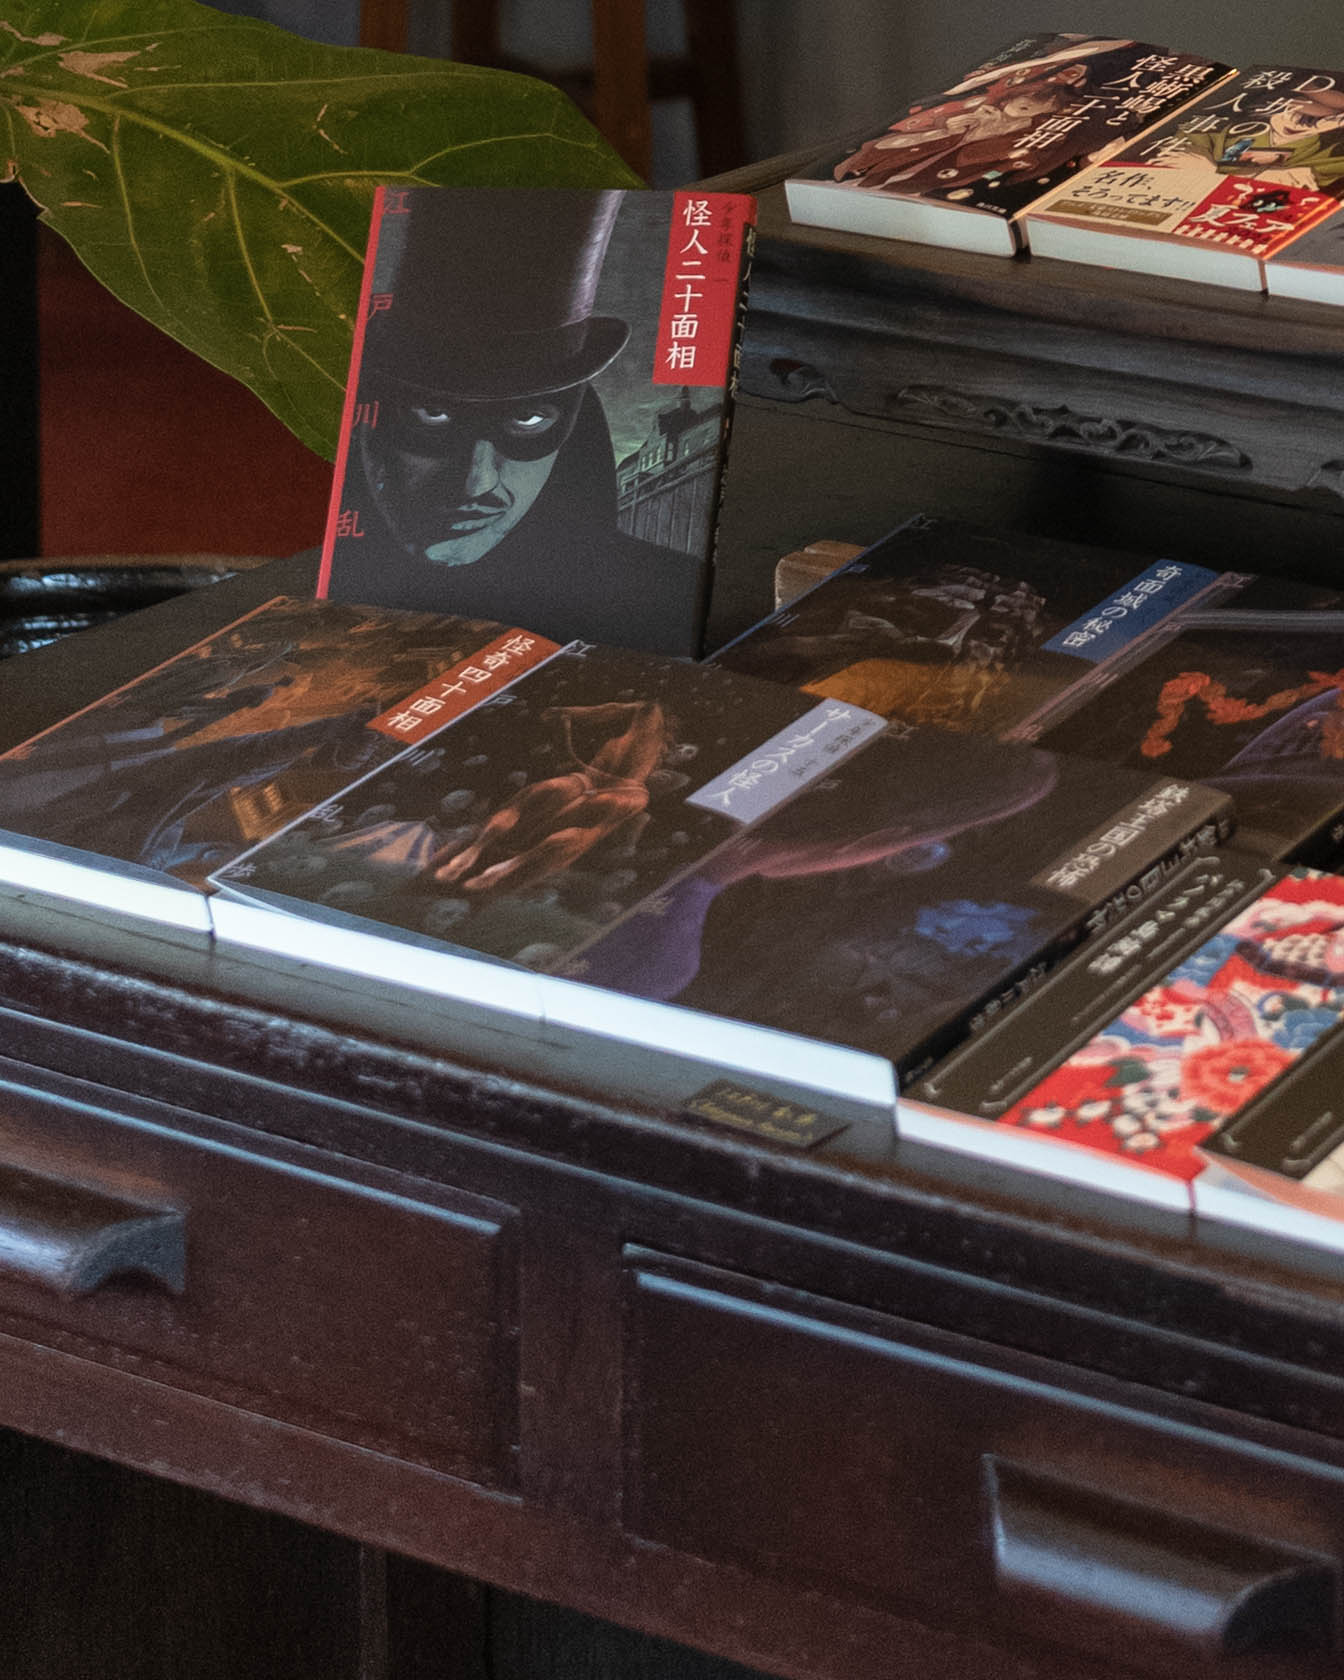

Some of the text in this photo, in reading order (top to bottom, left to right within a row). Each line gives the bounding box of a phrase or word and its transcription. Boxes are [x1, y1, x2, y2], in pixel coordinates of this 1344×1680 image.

[1012, 53, 1178, 148] 怪人二十面相
[1140, 70, 1294, 157] 殺人事件
[665, 198, 713, 370] 怪人二十面相
[1062, 564, 1184, 650] 奇面城の秘密
[387, 635, 537, 732] 怪奇四十面相
[710, 707, 852, 807] サーカスの怪人
